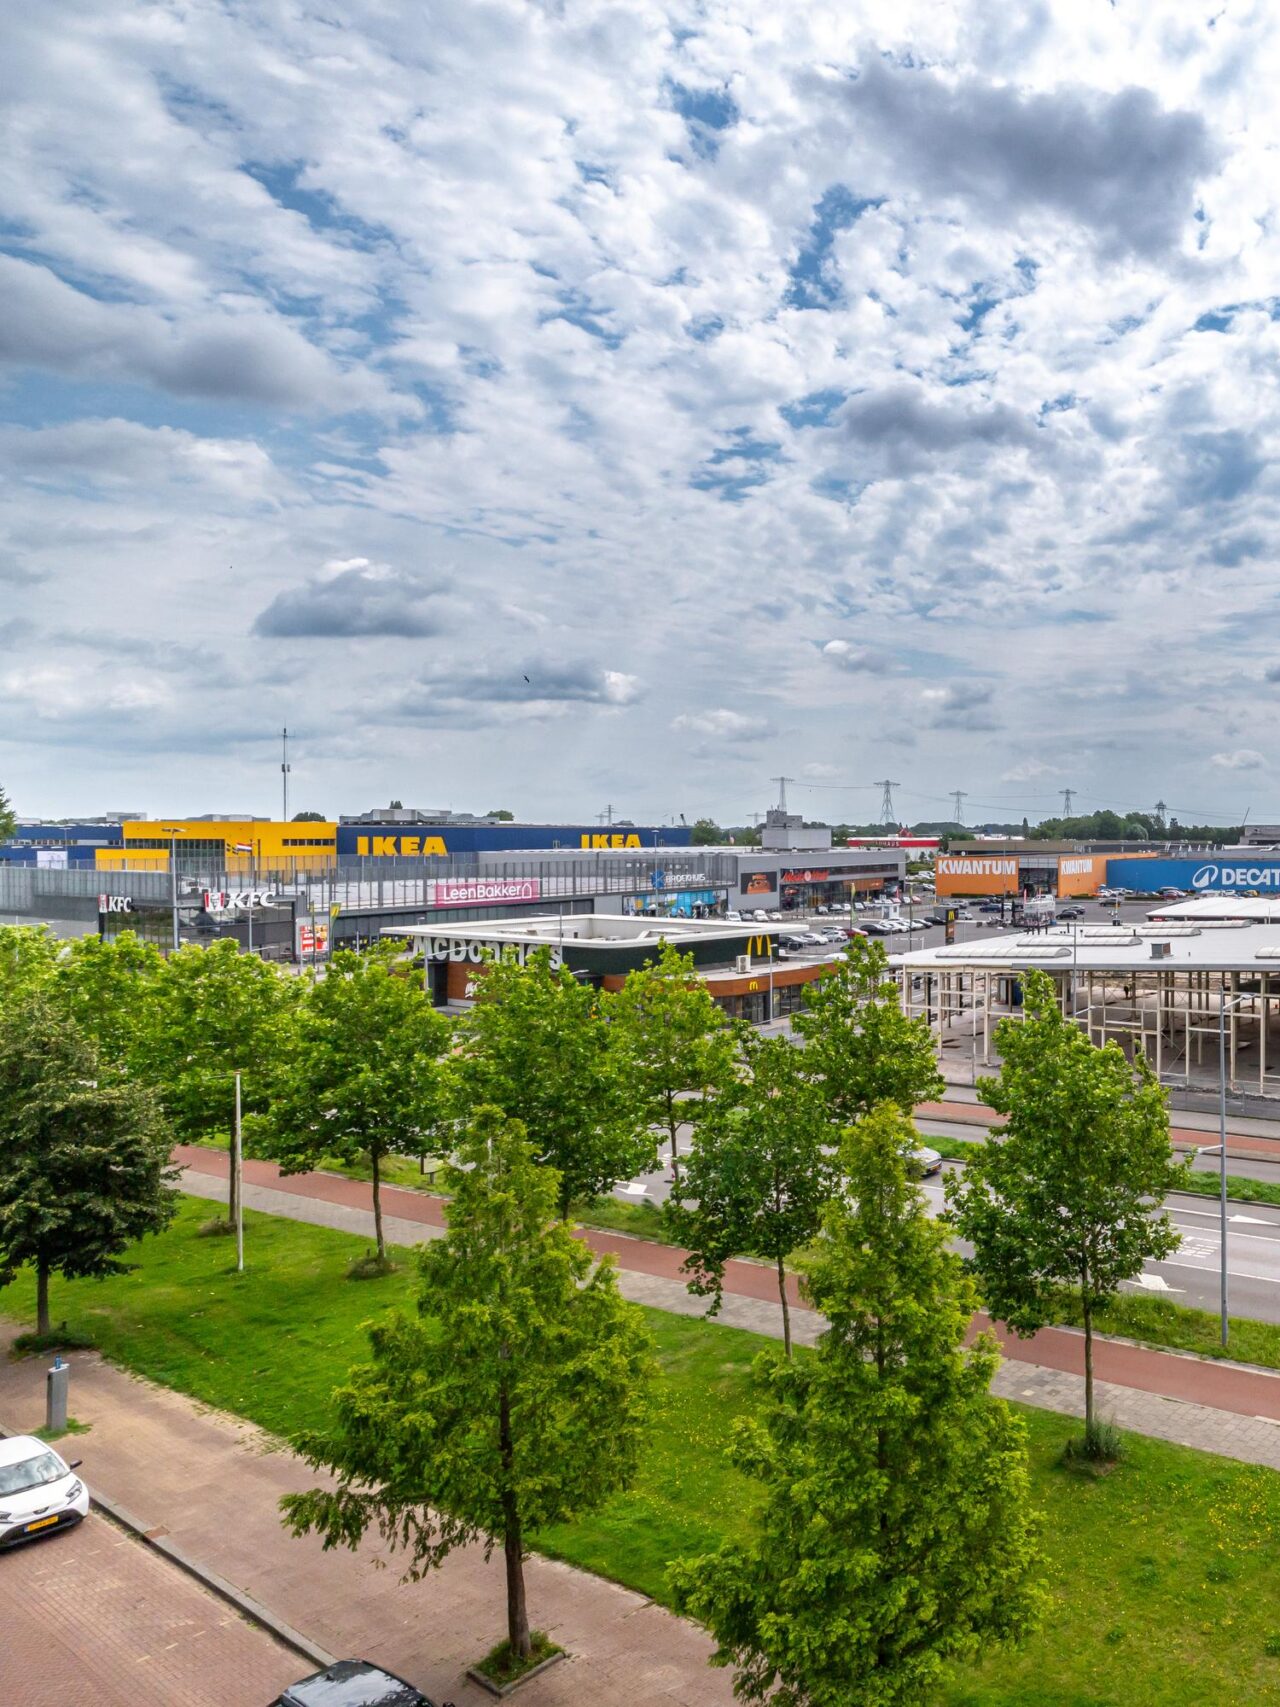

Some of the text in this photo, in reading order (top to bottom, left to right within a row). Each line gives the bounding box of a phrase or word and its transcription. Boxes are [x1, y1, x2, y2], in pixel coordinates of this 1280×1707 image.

[357, 836, 448, 856] IKEA
[581, 834, 641, 849] IKEA
[938, 860, 1016, 875] KWANTUM
[1061, 859, 1093, 875] KWANTUM
[227, 892, 276, 908] KFC
[443, 884, 521, 900] LeenBakker
[108, 896, 132, 912] KFC
